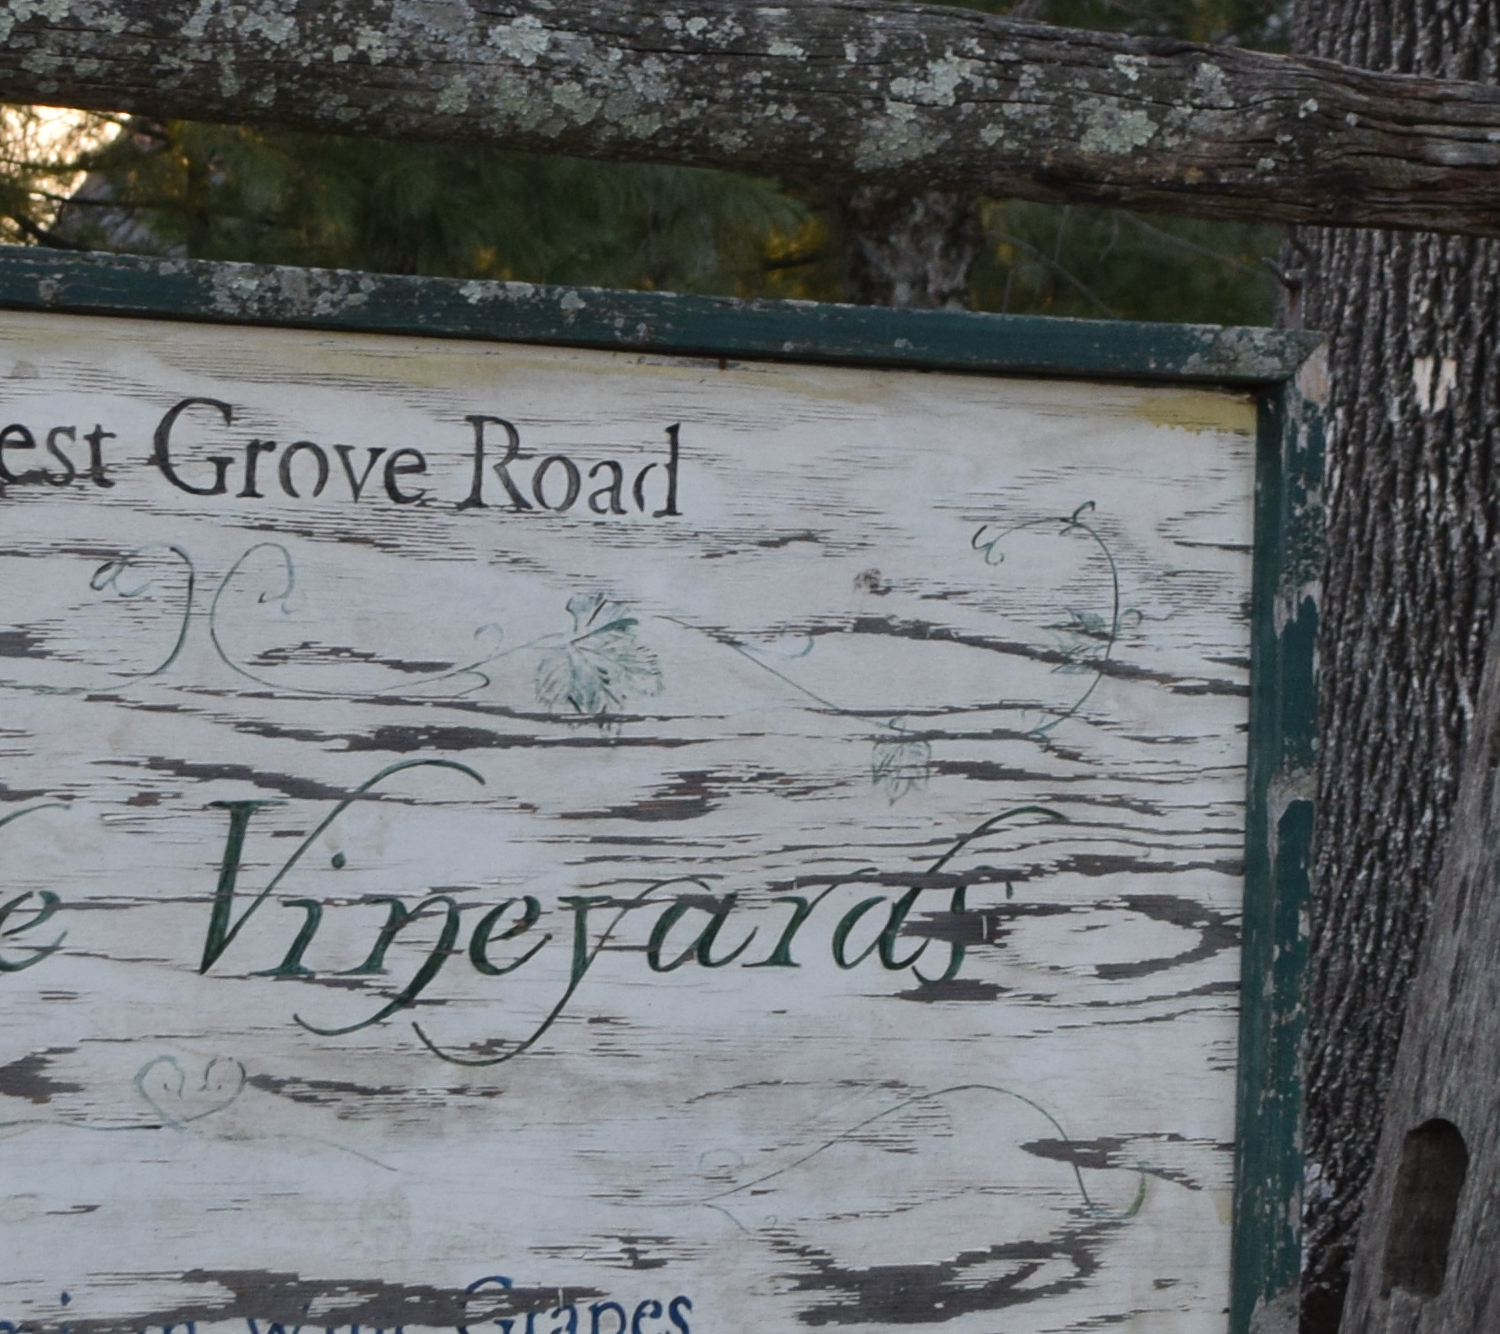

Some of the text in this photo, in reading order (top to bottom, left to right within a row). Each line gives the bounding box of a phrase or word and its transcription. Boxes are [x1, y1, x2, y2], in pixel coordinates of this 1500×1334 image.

[150, 397, 428, 505] Grove
[457, 415, 681, 518] Road
[198, 757, 1067, 1067] Vineyards
